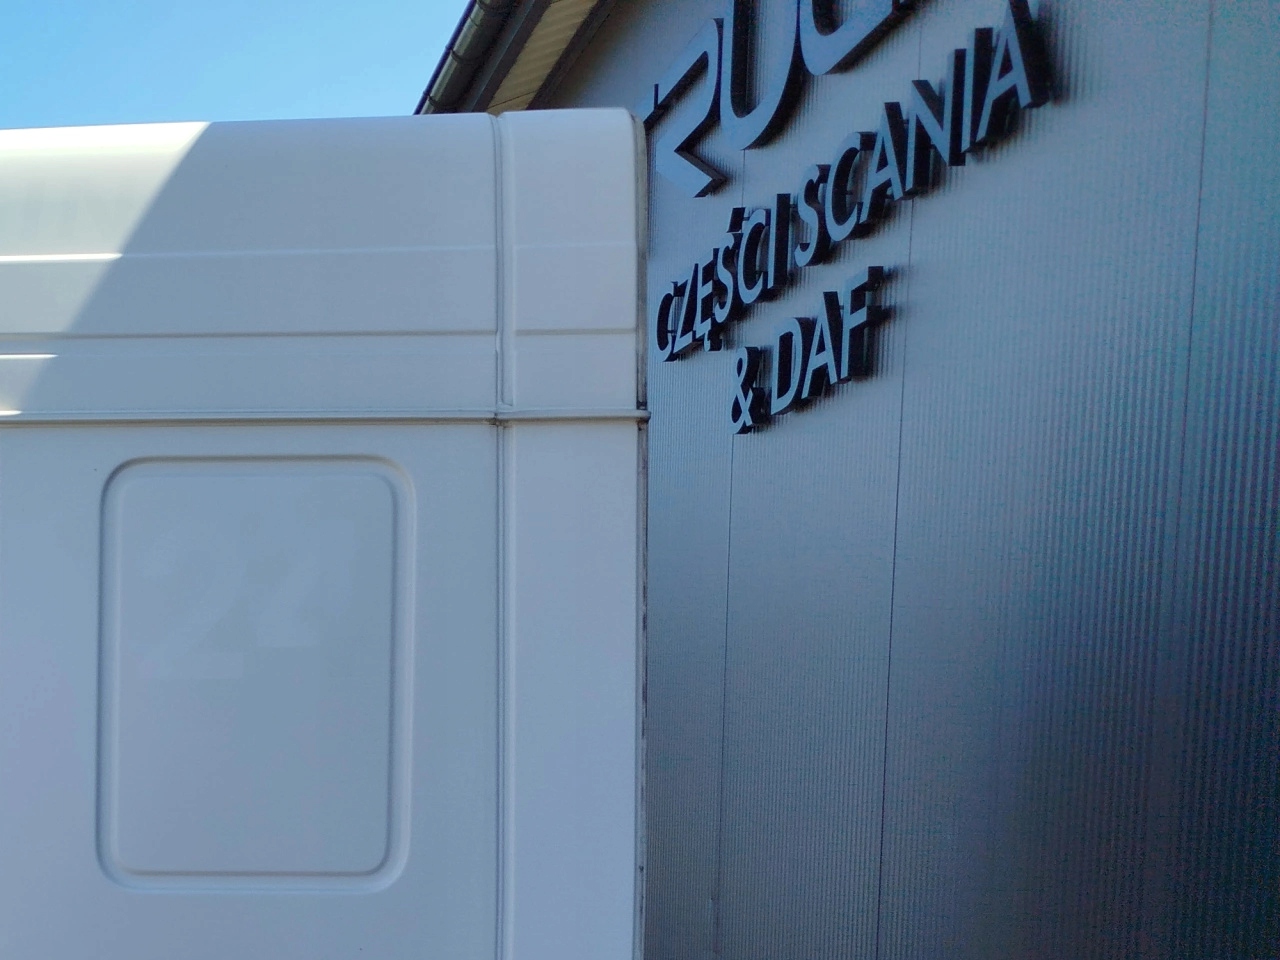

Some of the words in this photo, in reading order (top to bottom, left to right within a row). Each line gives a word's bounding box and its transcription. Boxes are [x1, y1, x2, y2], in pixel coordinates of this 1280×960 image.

[655, 192, 790, 362] CZĘŚCI
[794, 0, 1048, 267] SCANIA
[731, 346, 768, 434] &
[771, 266, 884, 415] DAF
